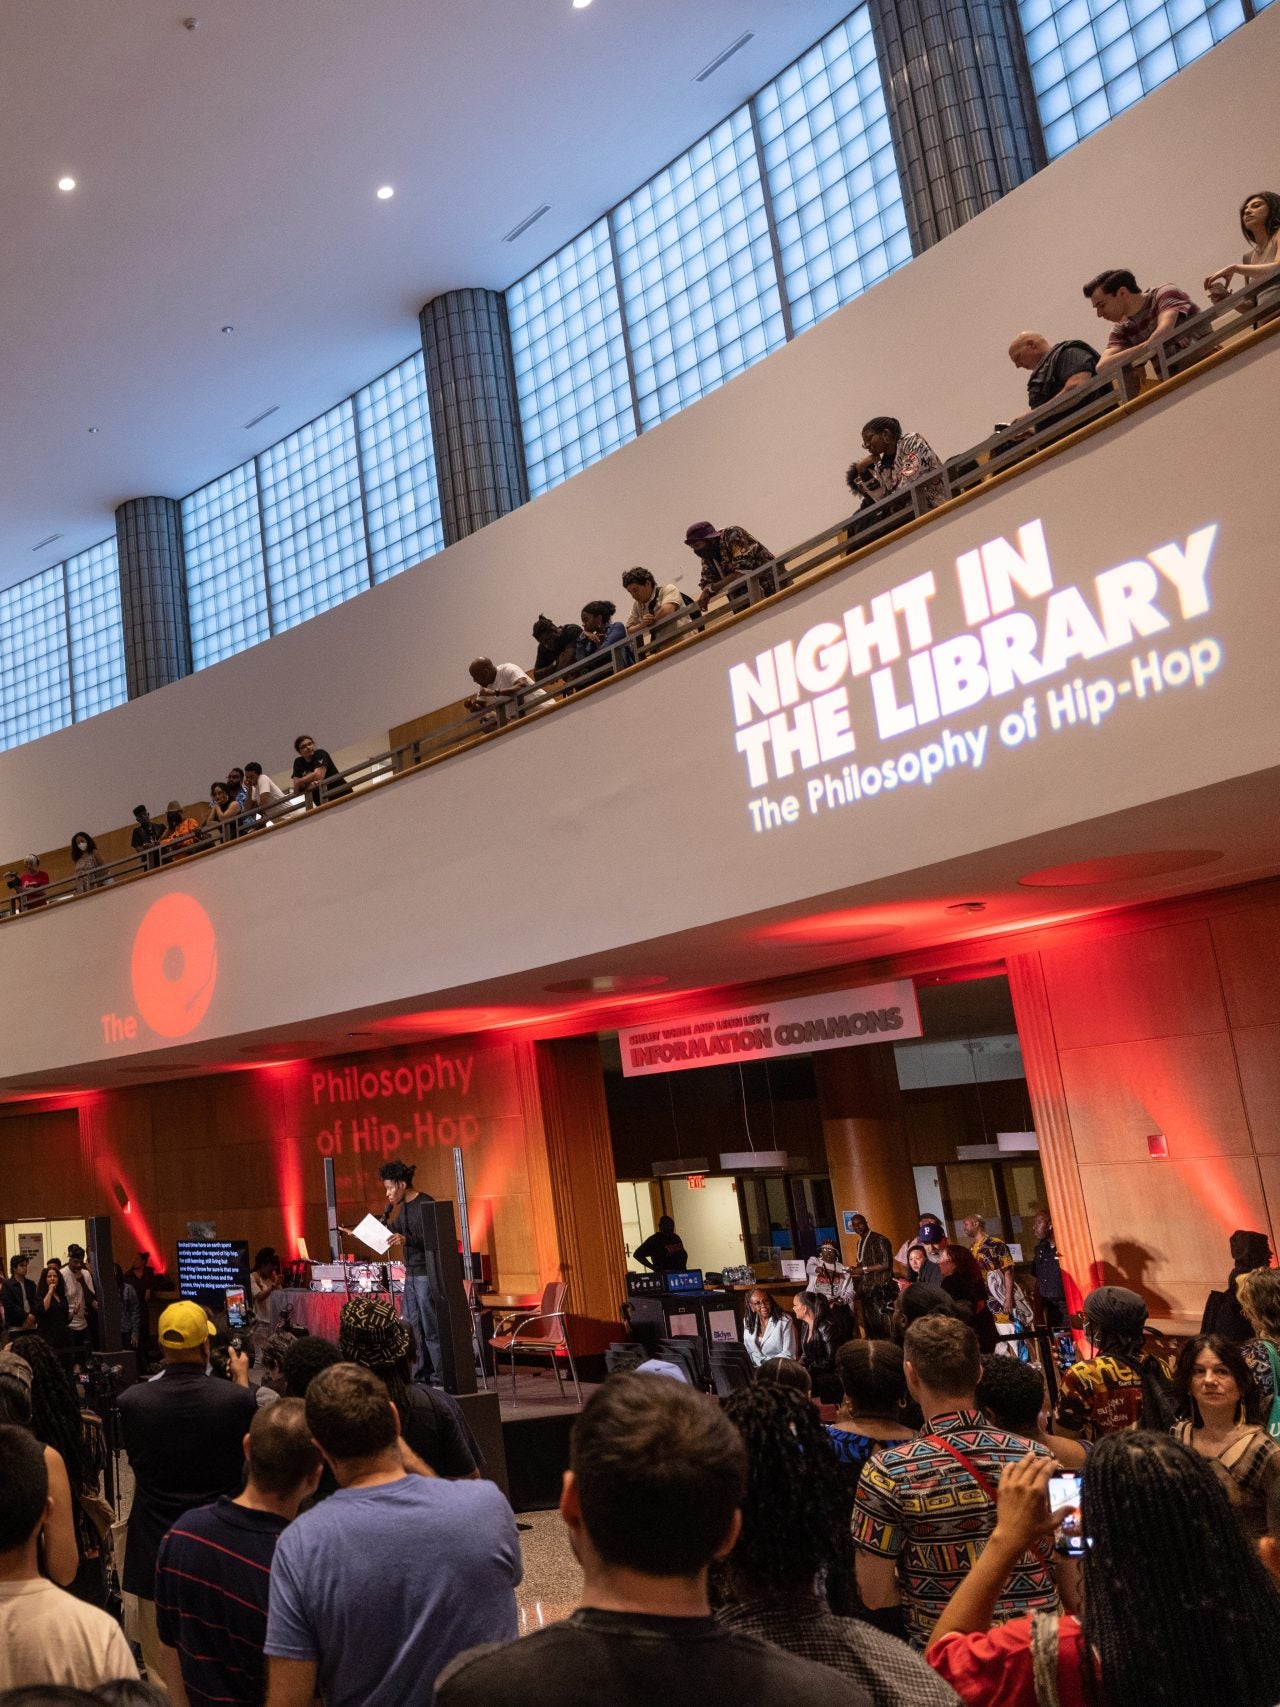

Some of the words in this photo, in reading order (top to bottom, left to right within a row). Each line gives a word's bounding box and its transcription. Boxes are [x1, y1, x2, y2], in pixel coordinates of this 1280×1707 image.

[729, 571, 936, 726] NIGHT
[956, 518, 1054, 626] IN
[735, 686, 856, 788] THE
[870, 523, 1218, 740] LIBRARY
[748, 793, 801, 833] The
[807, 724, 989, 815] Philosophy
[998, 695, 1039, 747] of
[1046, 637, 1222, 731] Hip-Hop
[101, 1013, 138, 1044] The
[630, 1027, 773, 1068] INFORMATION
[773, 1006, 904, 1047] COMMONS
[692, 1022, 715, 1035] AND
[312, 1053, 474, 1104] Philosophy
[316, 1119, 343, 1155] of
[351, 1110, 480, 1160] Hip-Hop
